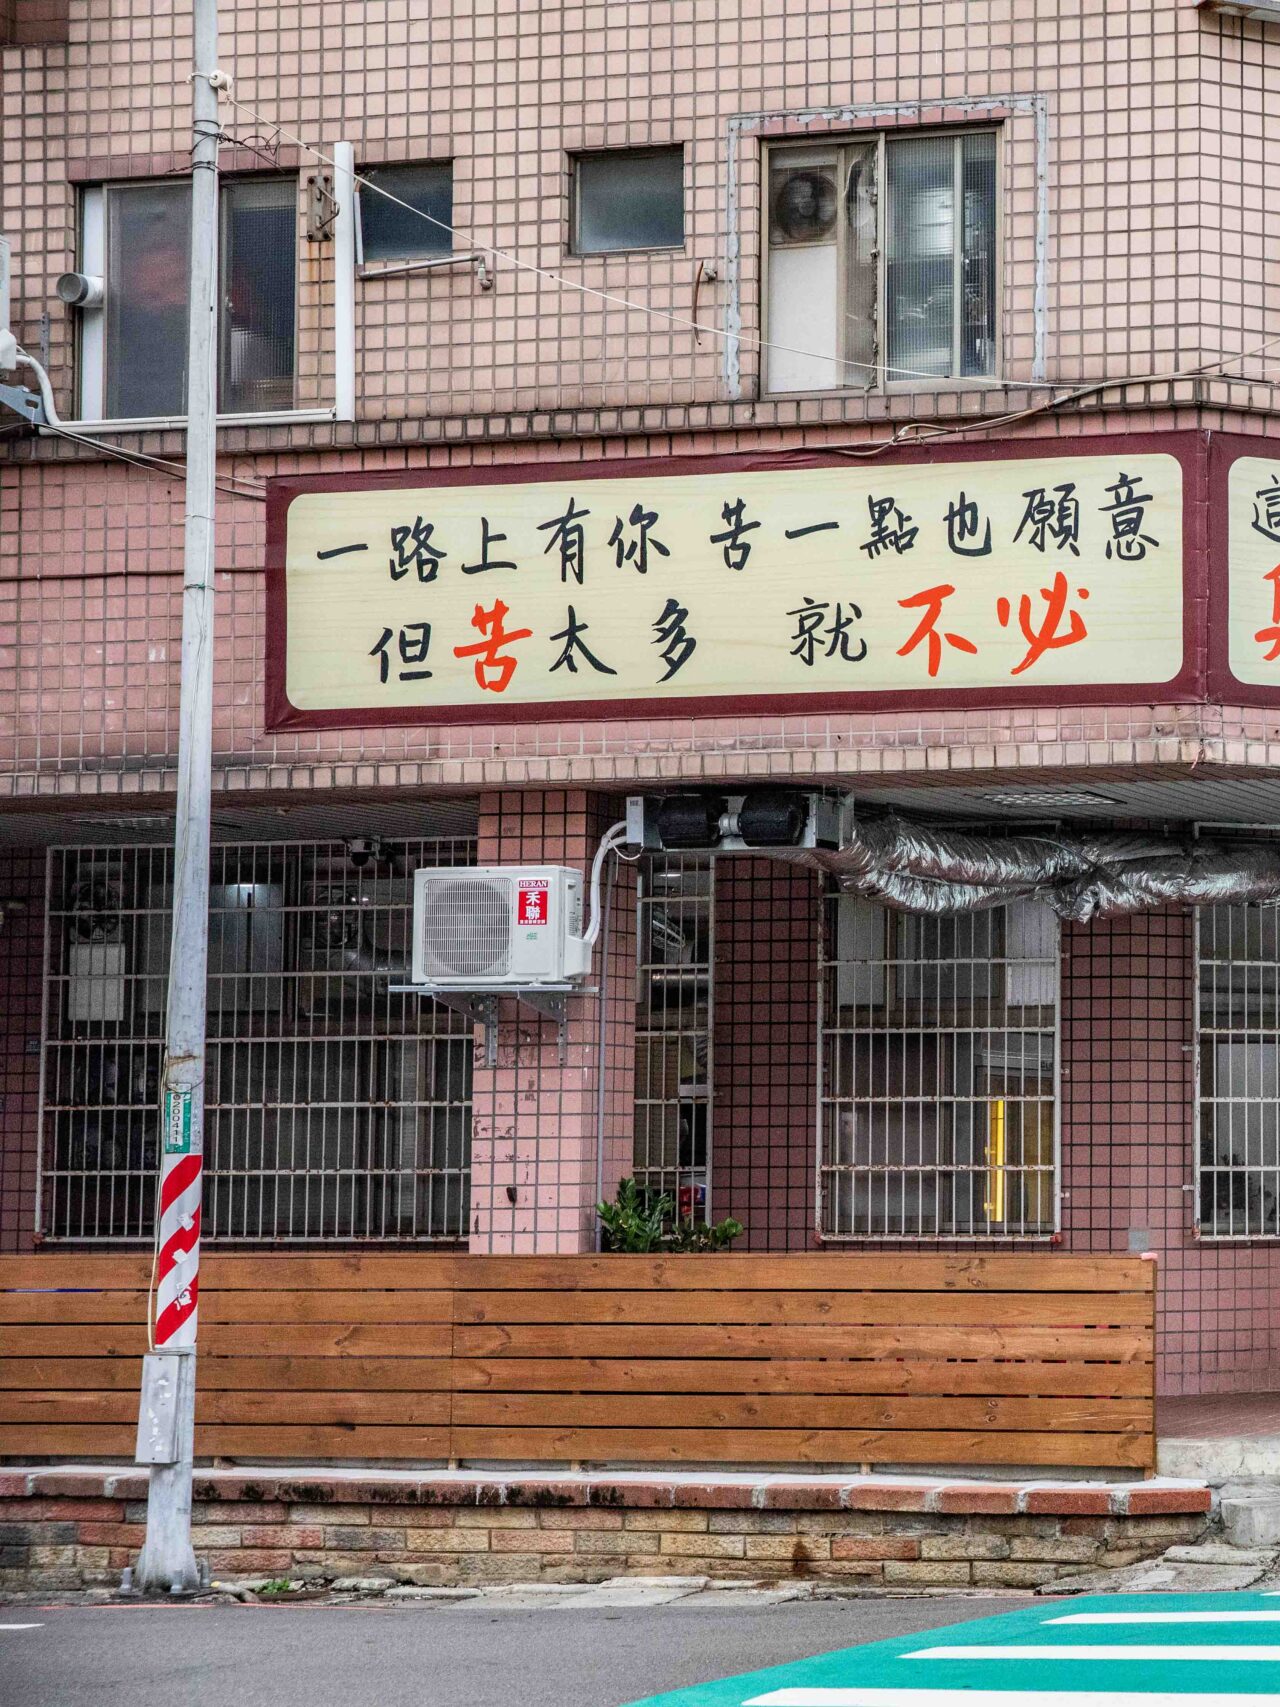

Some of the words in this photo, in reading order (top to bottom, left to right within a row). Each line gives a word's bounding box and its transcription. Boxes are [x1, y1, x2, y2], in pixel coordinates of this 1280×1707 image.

[316, 497, 670, 582] 一路上有你
[709, 471, 1160, 571] 苦一點也願意
[370, 599, 697, 692] 但苦太多
[789, 572, 1090, 676] 就不必
[525, 891, 541, 920] 禾聯
